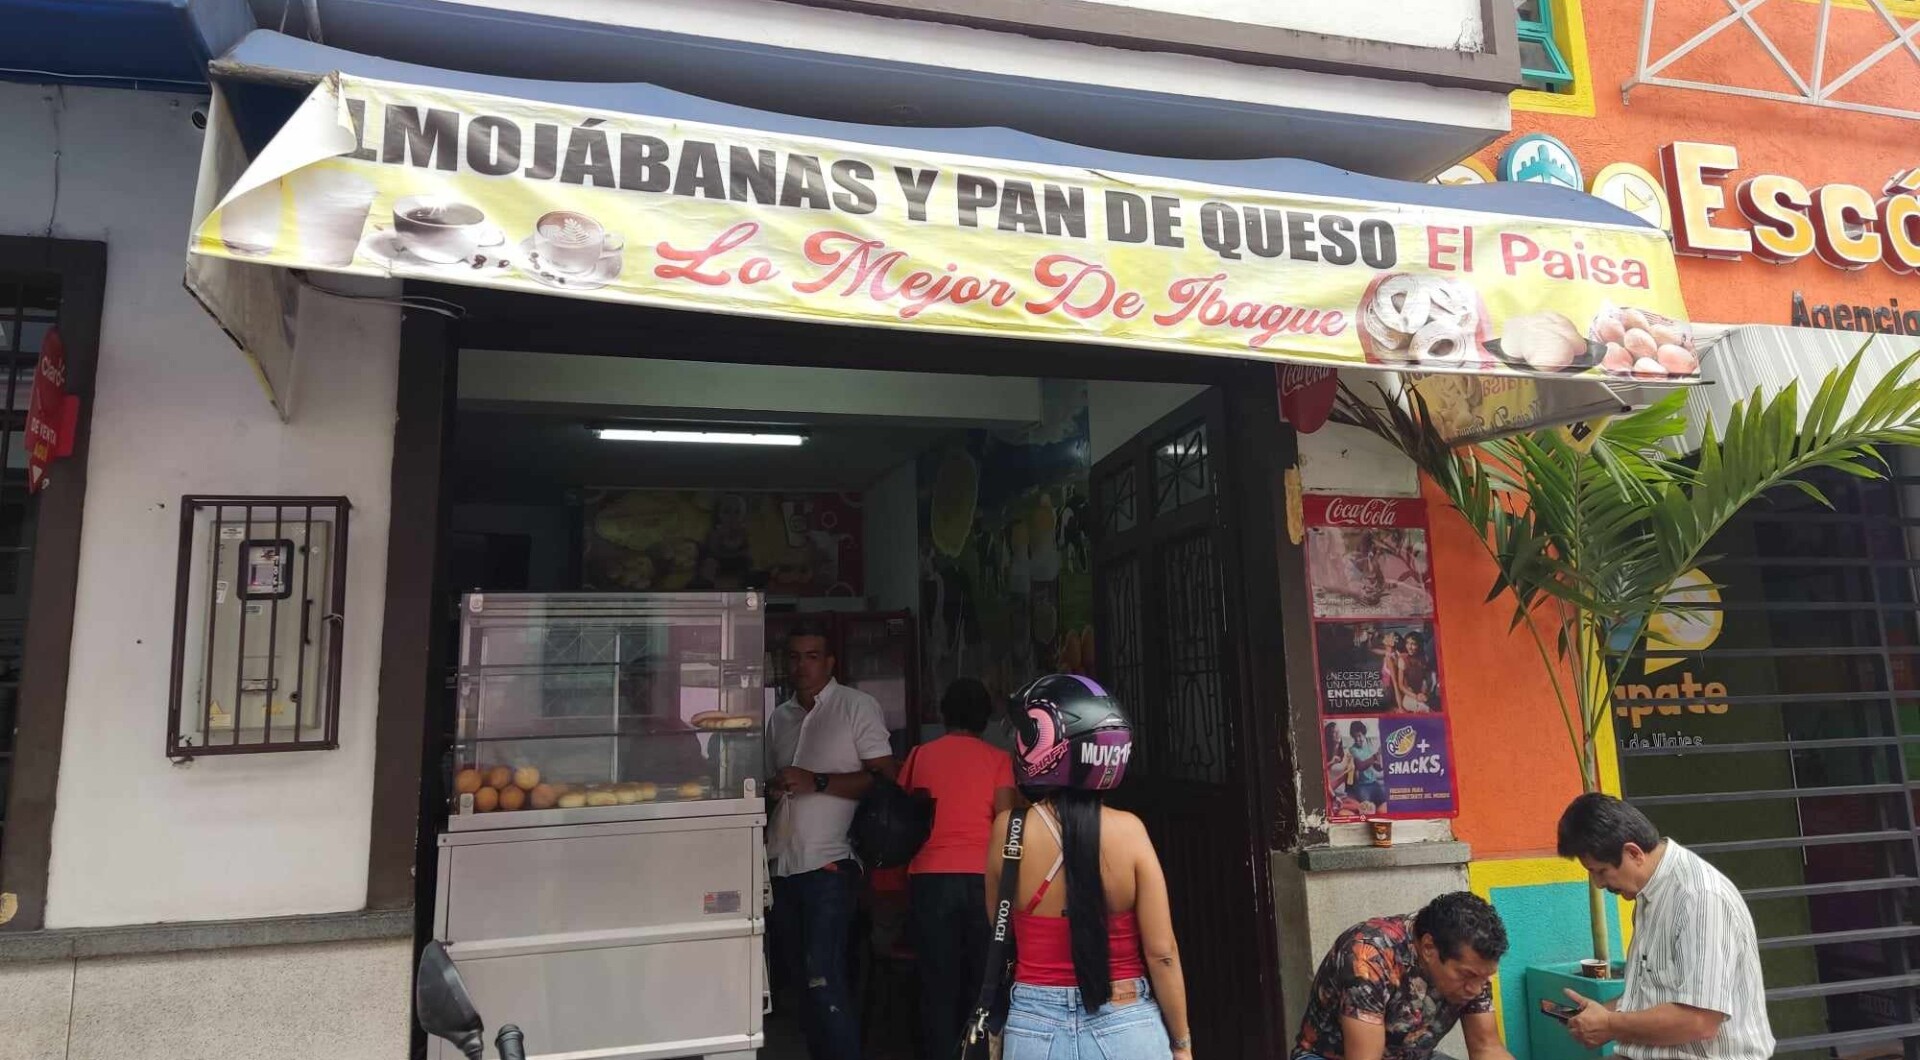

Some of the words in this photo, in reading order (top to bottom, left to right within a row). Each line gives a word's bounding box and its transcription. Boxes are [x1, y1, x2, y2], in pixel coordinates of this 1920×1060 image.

[894, 166, 938, 222] Y
[957, 173, 1087, 239] PAN
[1105, 190, 1185, 249] DE
[1200, 201, 1397, 270] QUESO
[1426, 225, 1474, 273] El
[1500, 232, 1650, 290] Paisa
[654, 222, 780, 286] Lo
[792, 230, 1015, 319] Mejor
[1025, 254, 1144, 319] De
[1153, 273, 1347, 348] Ibague
[41, 357, 61, 387] Claro
[30, 417, 39, 434] DE
[39, 424, 57, 446] VENTA
[1325, 498, 1398, 526] Coca-Cola
[1326, 671, 1380, 681] ¿NECESITAS
[1326, 680, 1347, 689] UNA
[1348, 679, 1383, 689] PAUSA?
[1327, 688, 1385, 698] ENCIENDE
[1328, 699, 1343, 708] TU
[1345, 697, 1380, 708] MAGIA
[1389, 754, 1445, 777] SNACKS,
[994, 899, 1011, 942] COACH
